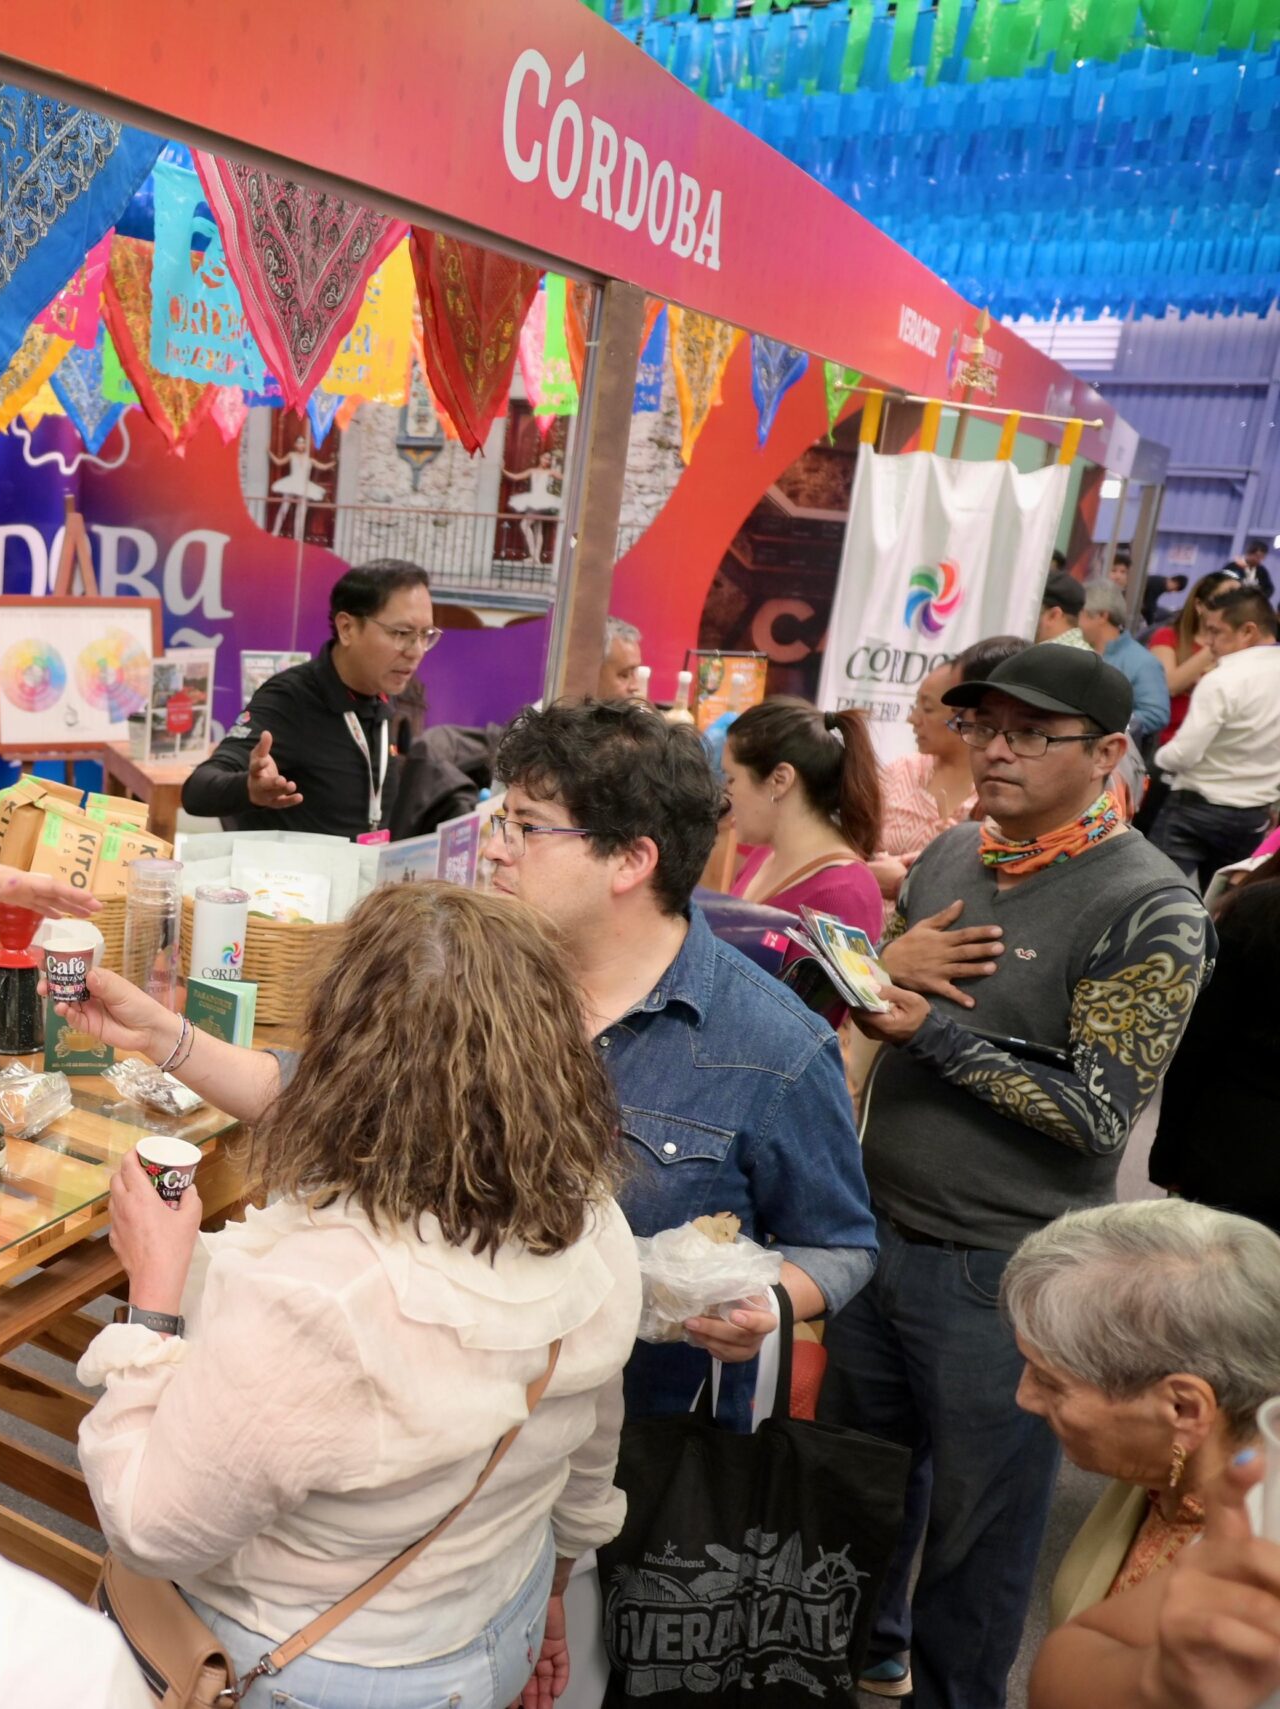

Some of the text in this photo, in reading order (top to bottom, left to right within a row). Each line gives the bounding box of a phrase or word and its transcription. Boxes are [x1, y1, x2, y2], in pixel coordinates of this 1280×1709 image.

[502, 49, 723, 272] CÓRDOBA
[70, 833, 97, 889] KITO
[46, 955, 85, 975] Café
